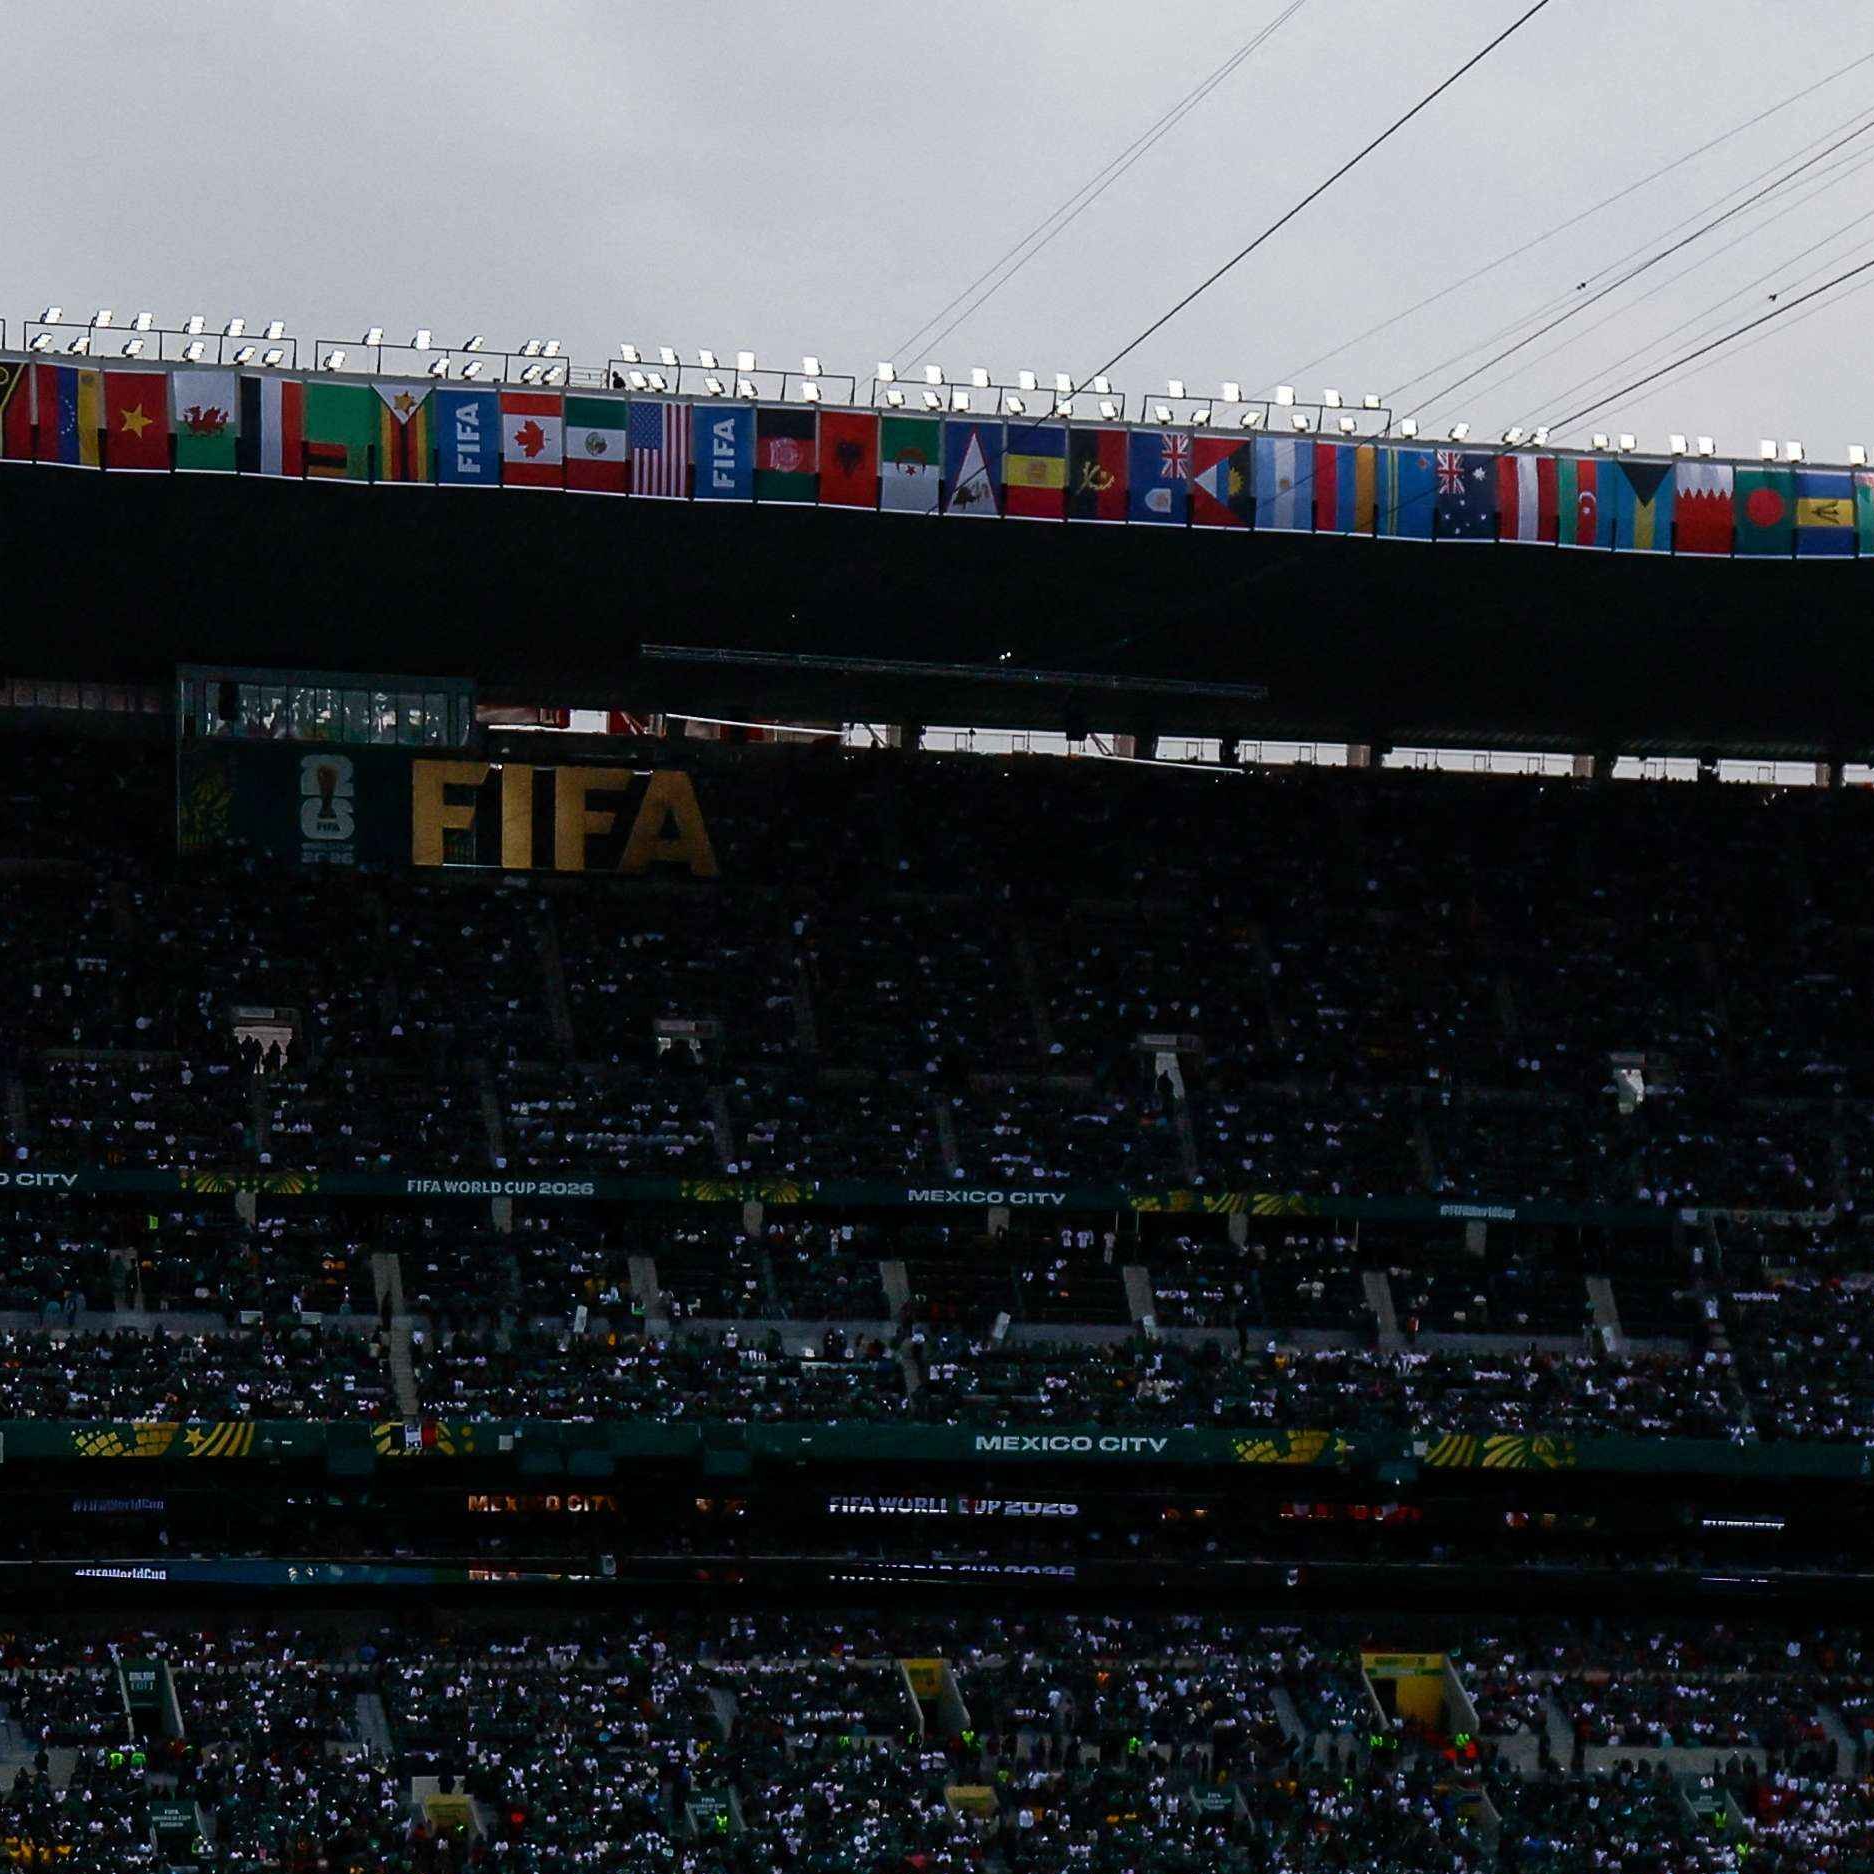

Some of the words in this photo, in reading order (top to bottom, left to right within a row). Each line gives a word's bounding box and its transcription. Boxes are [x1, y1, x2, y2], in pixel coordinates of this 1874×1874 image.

[456, 402, 481, 474] FIFA
[712, 417, 736, 489] FIFA
[412, 758, 719, 878] FIFA
[15, 1173, 78, 1187] CITY
[407, 1179, 441, 1193] FIFA
[443, 1180, 501, 1194] WORLD
[504, 1181, 536, 1195] CUP
[538, 1183, 595, 1196] 2026
[908, 1189, 1004, 1204] MEXICO
[1009, 1191, 1066, 1206] CITY
[975, 1435, 1093, 1451] MEXICO
[1098, 1436, 1168, 1453] CITY
